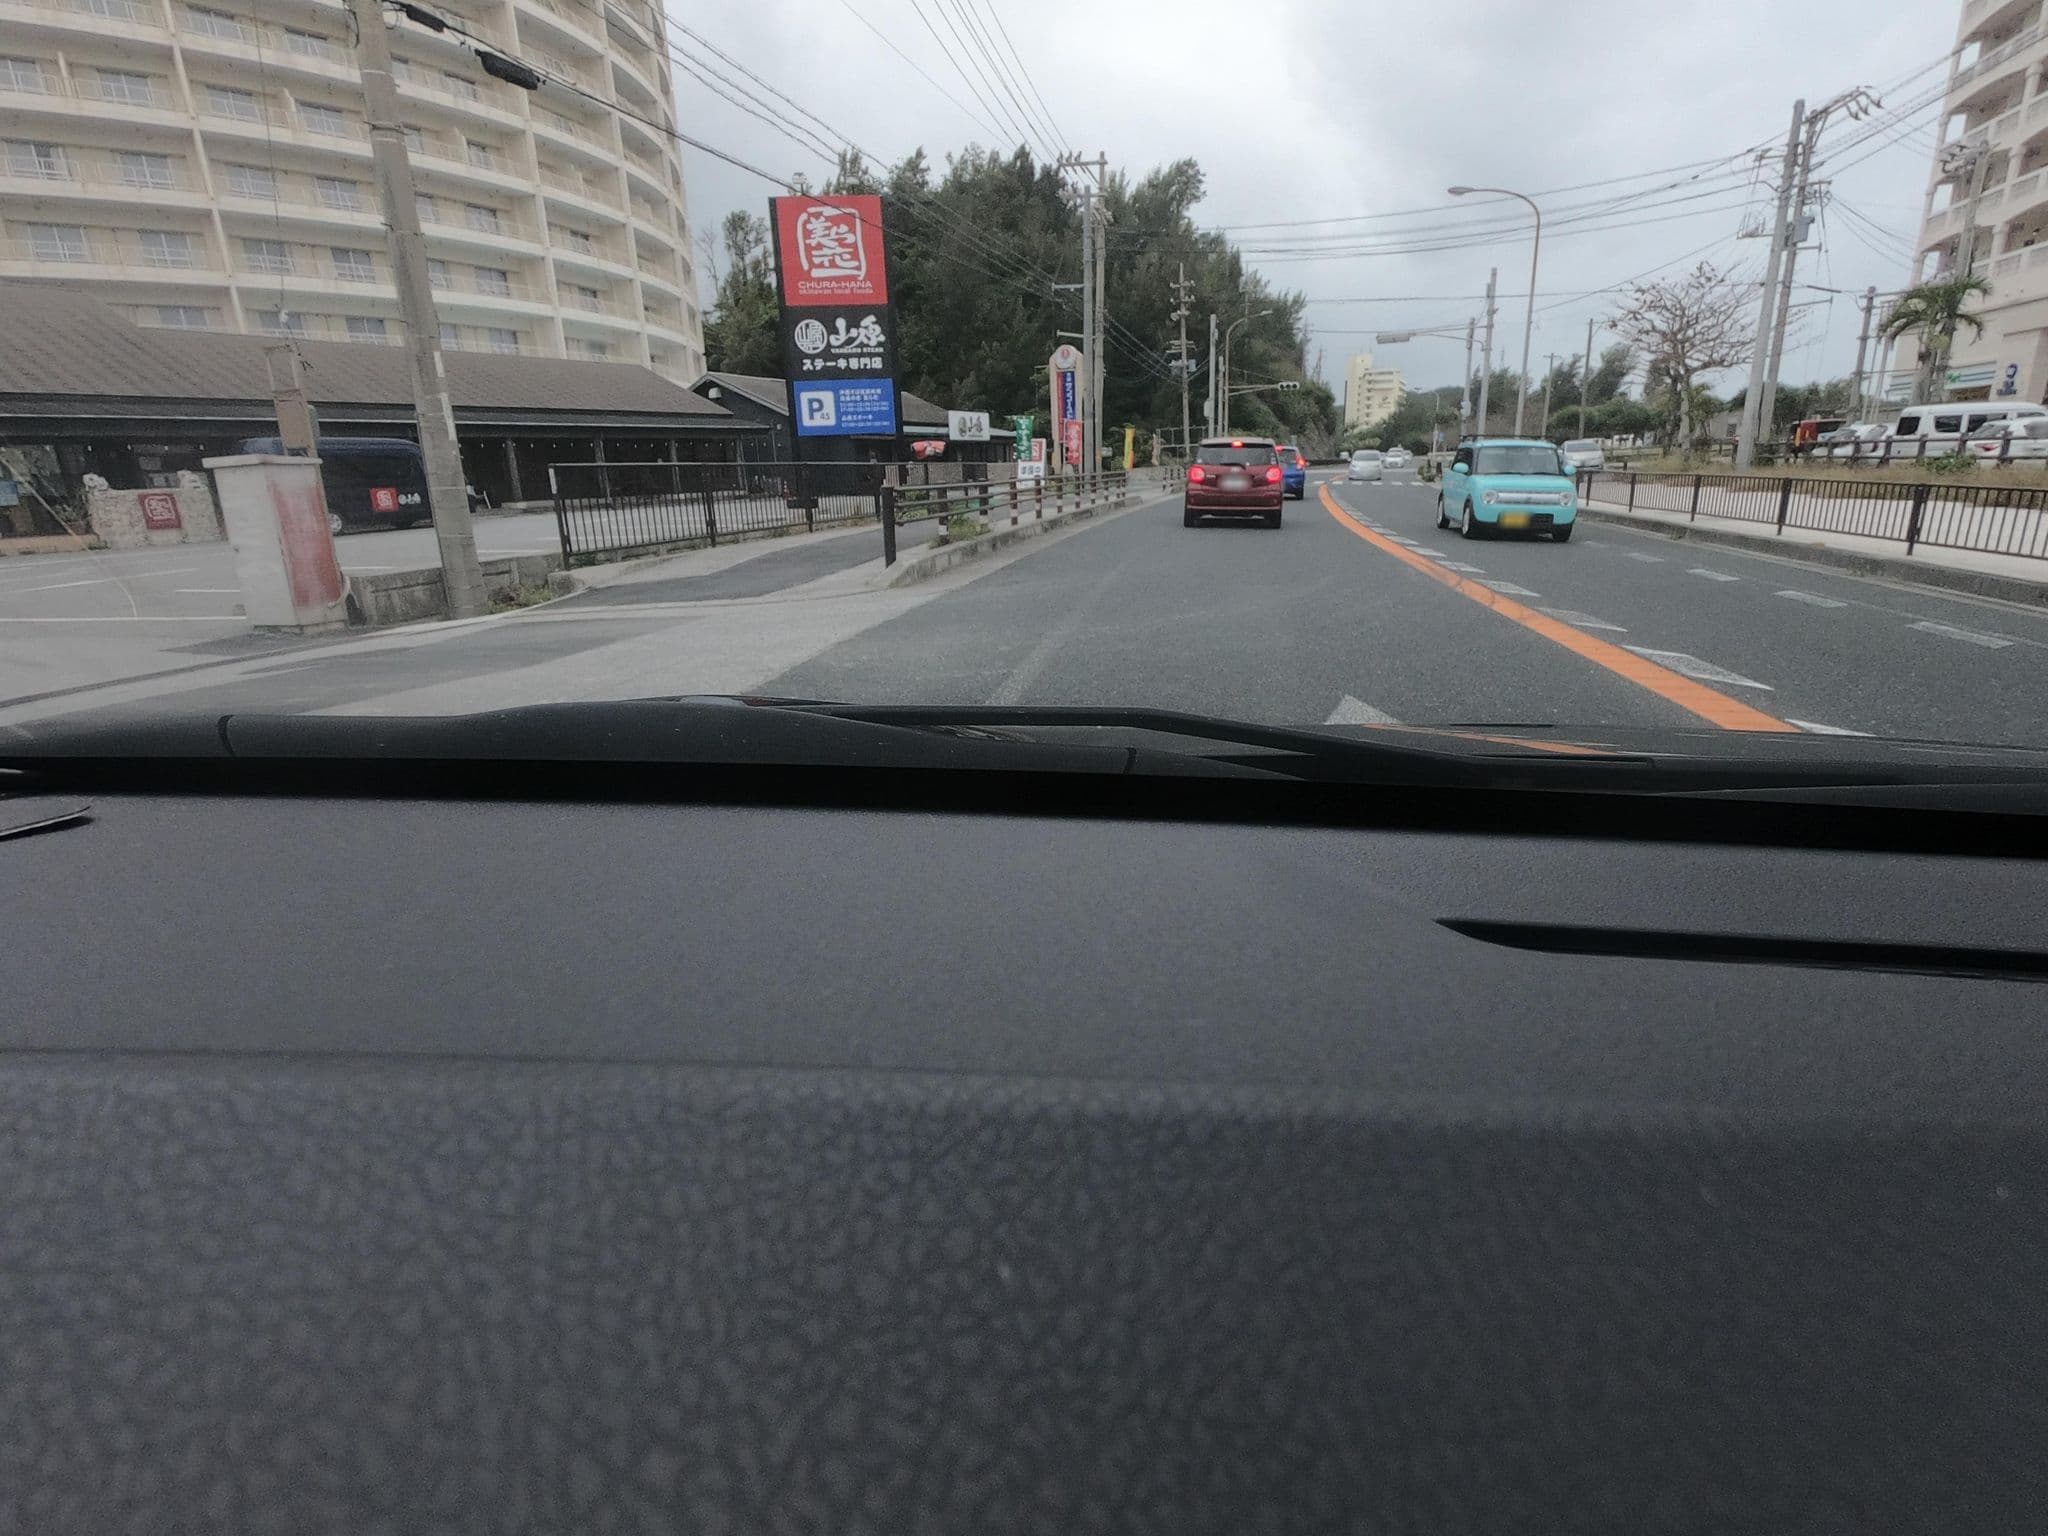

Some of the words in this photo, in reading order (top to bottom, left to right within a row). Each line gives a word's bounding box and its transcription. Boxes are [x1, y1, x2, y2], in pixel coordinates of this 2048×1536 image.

[797, 280, 873, 289] CHURA-HANA
[801, 356, 883, 371] ステーキ専門店
[807, 397, 824, 421] P
